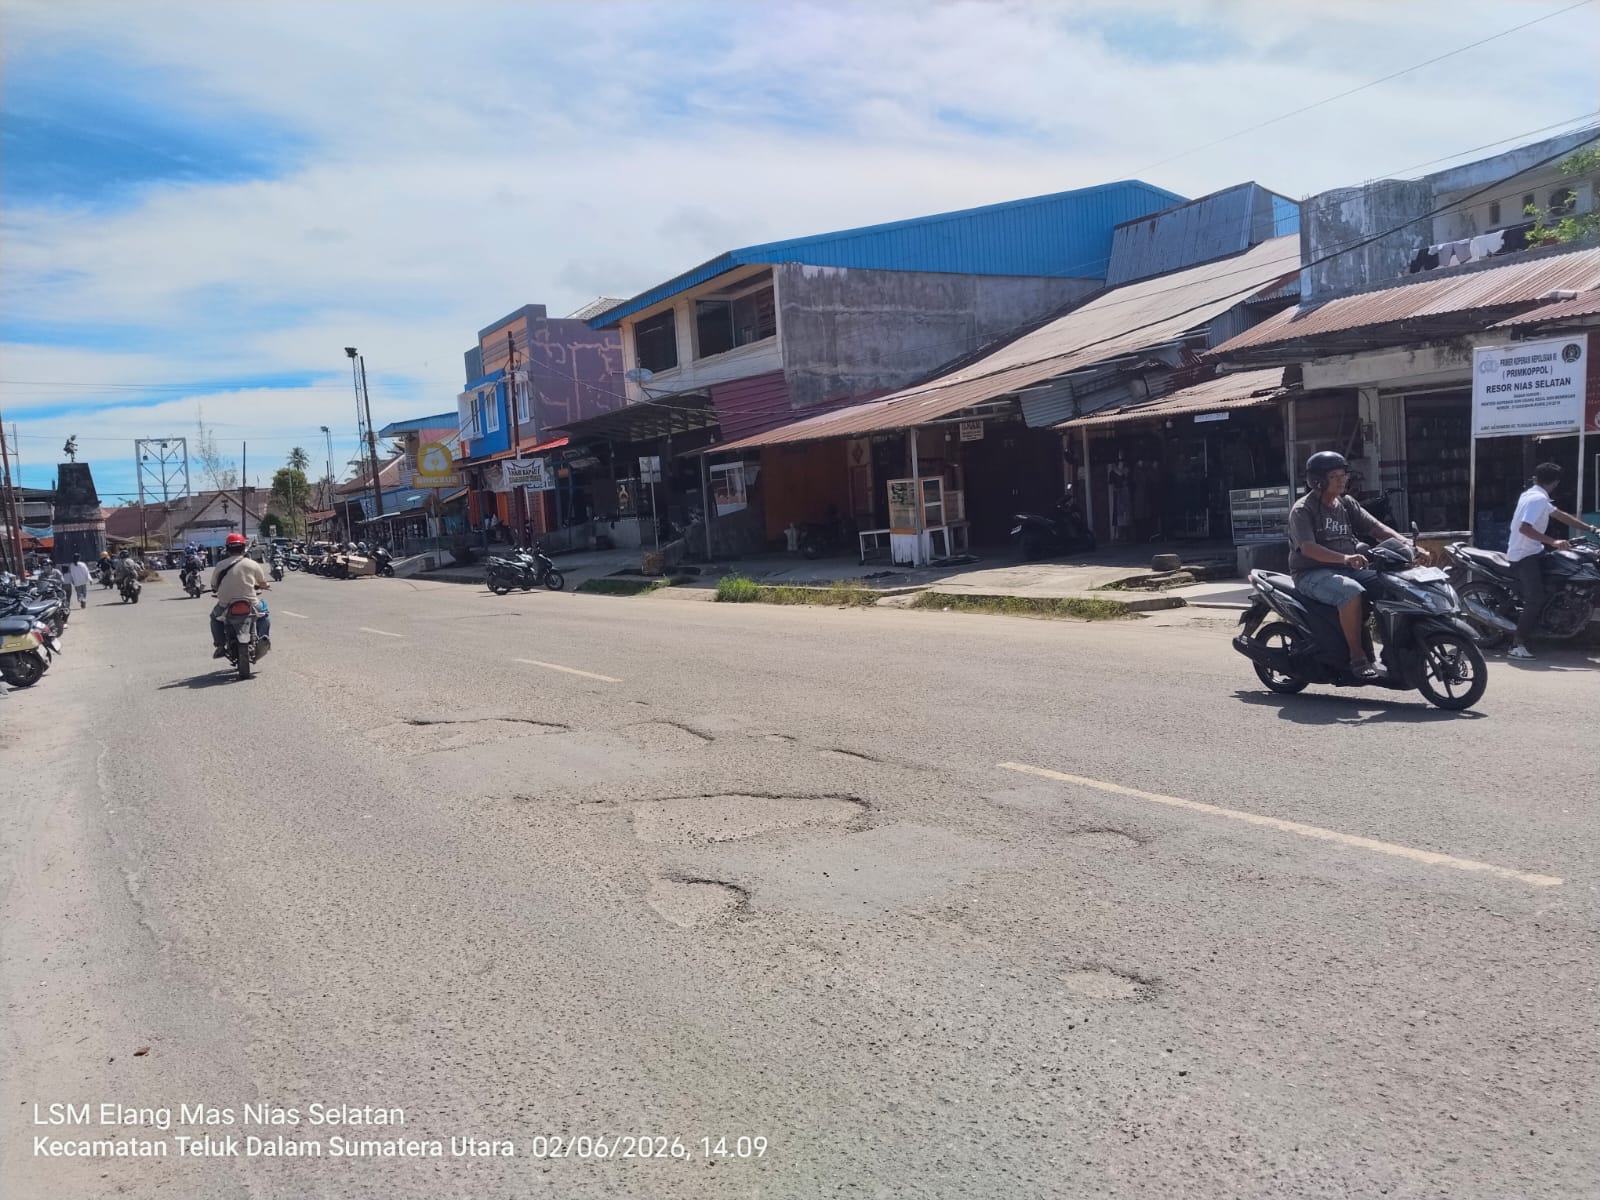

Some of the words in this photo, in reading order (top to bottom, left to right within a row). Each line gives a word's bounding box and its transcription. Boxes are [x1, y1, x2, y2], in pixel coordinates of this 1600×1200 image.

[1506, 365, 1549, 379] PRIMKOPPOL
[1486, 383, 1512, 394] RESOR
[1514, 381, 1533, 391] NIAS
[1535, 377, 1572, 389] SELATAN
